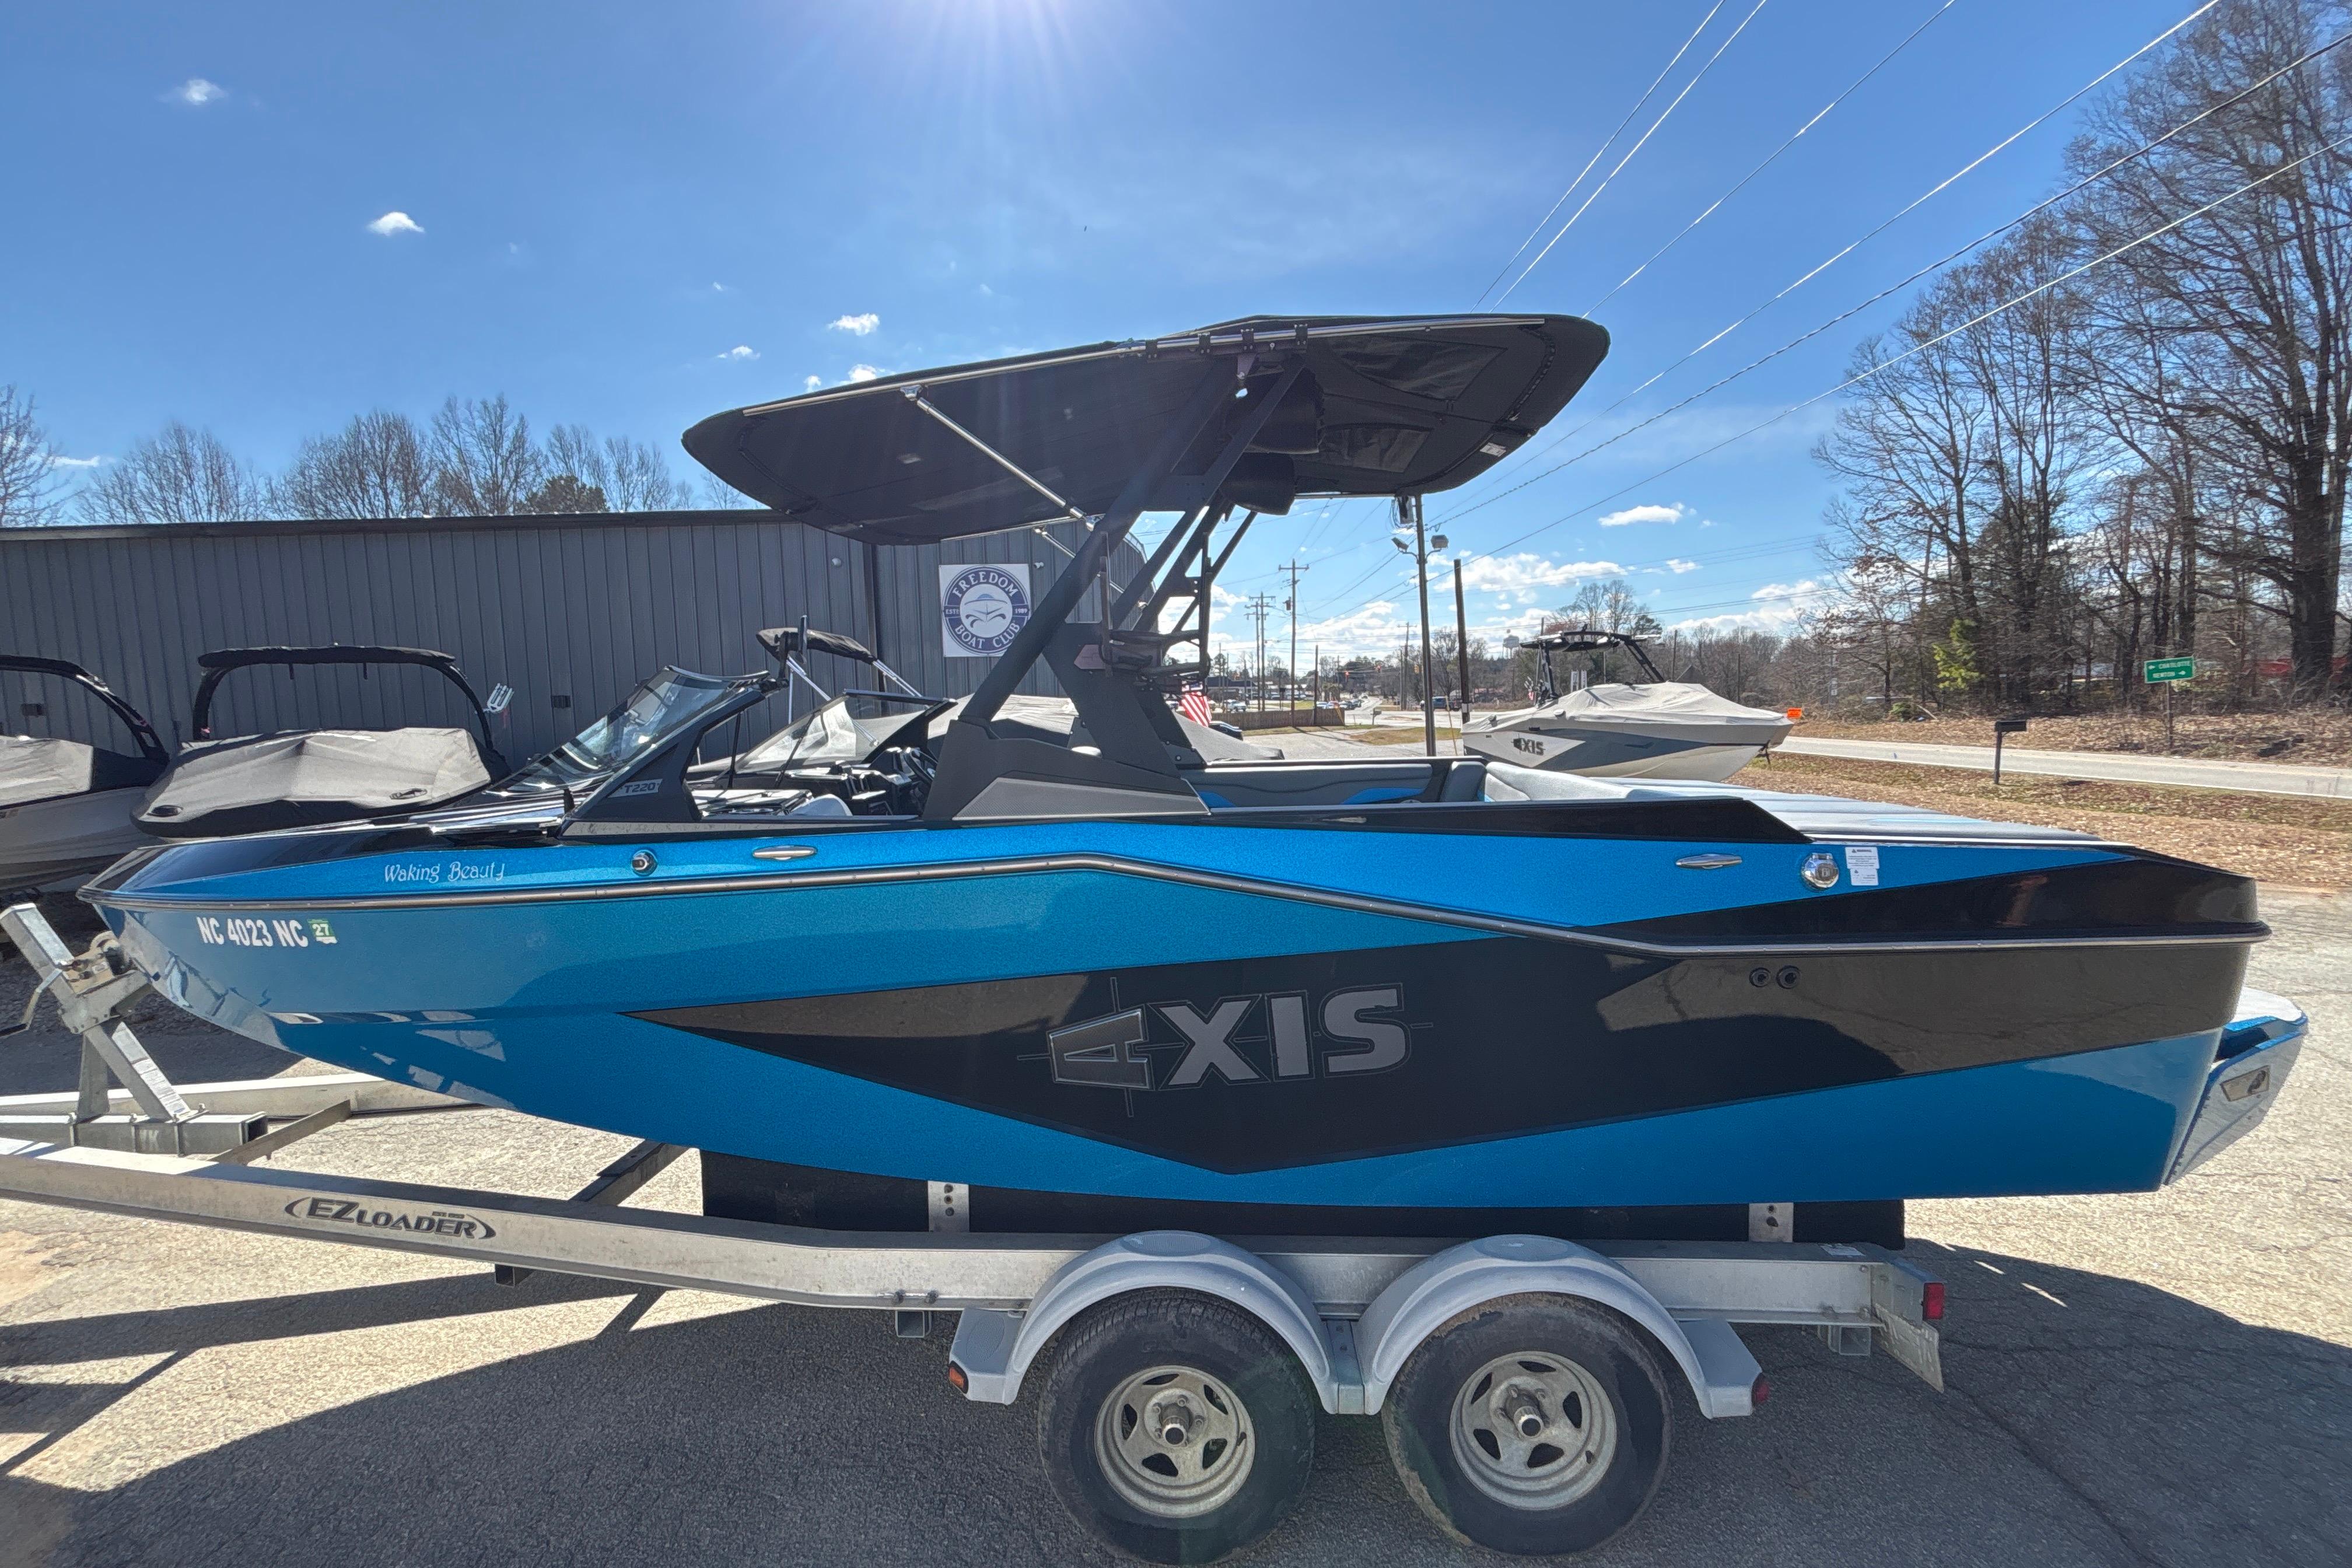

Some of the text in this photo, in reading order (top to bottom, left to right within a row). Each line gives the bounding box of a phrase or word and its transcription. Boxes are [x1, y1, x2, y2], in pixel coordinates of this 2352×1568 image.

[952, 571, 1019, 598] FREEDOM
[954, 622, 1020, 649] BOAT CLUB
[624, 782, 656, 794] T220
[384, 861, 505, 884] Waking Beauty
[196, 916, 309, 947] NC 4023 NC
[312, 923, 330, 936] 27
[1046, 982, 1410, 1091] AXIS
